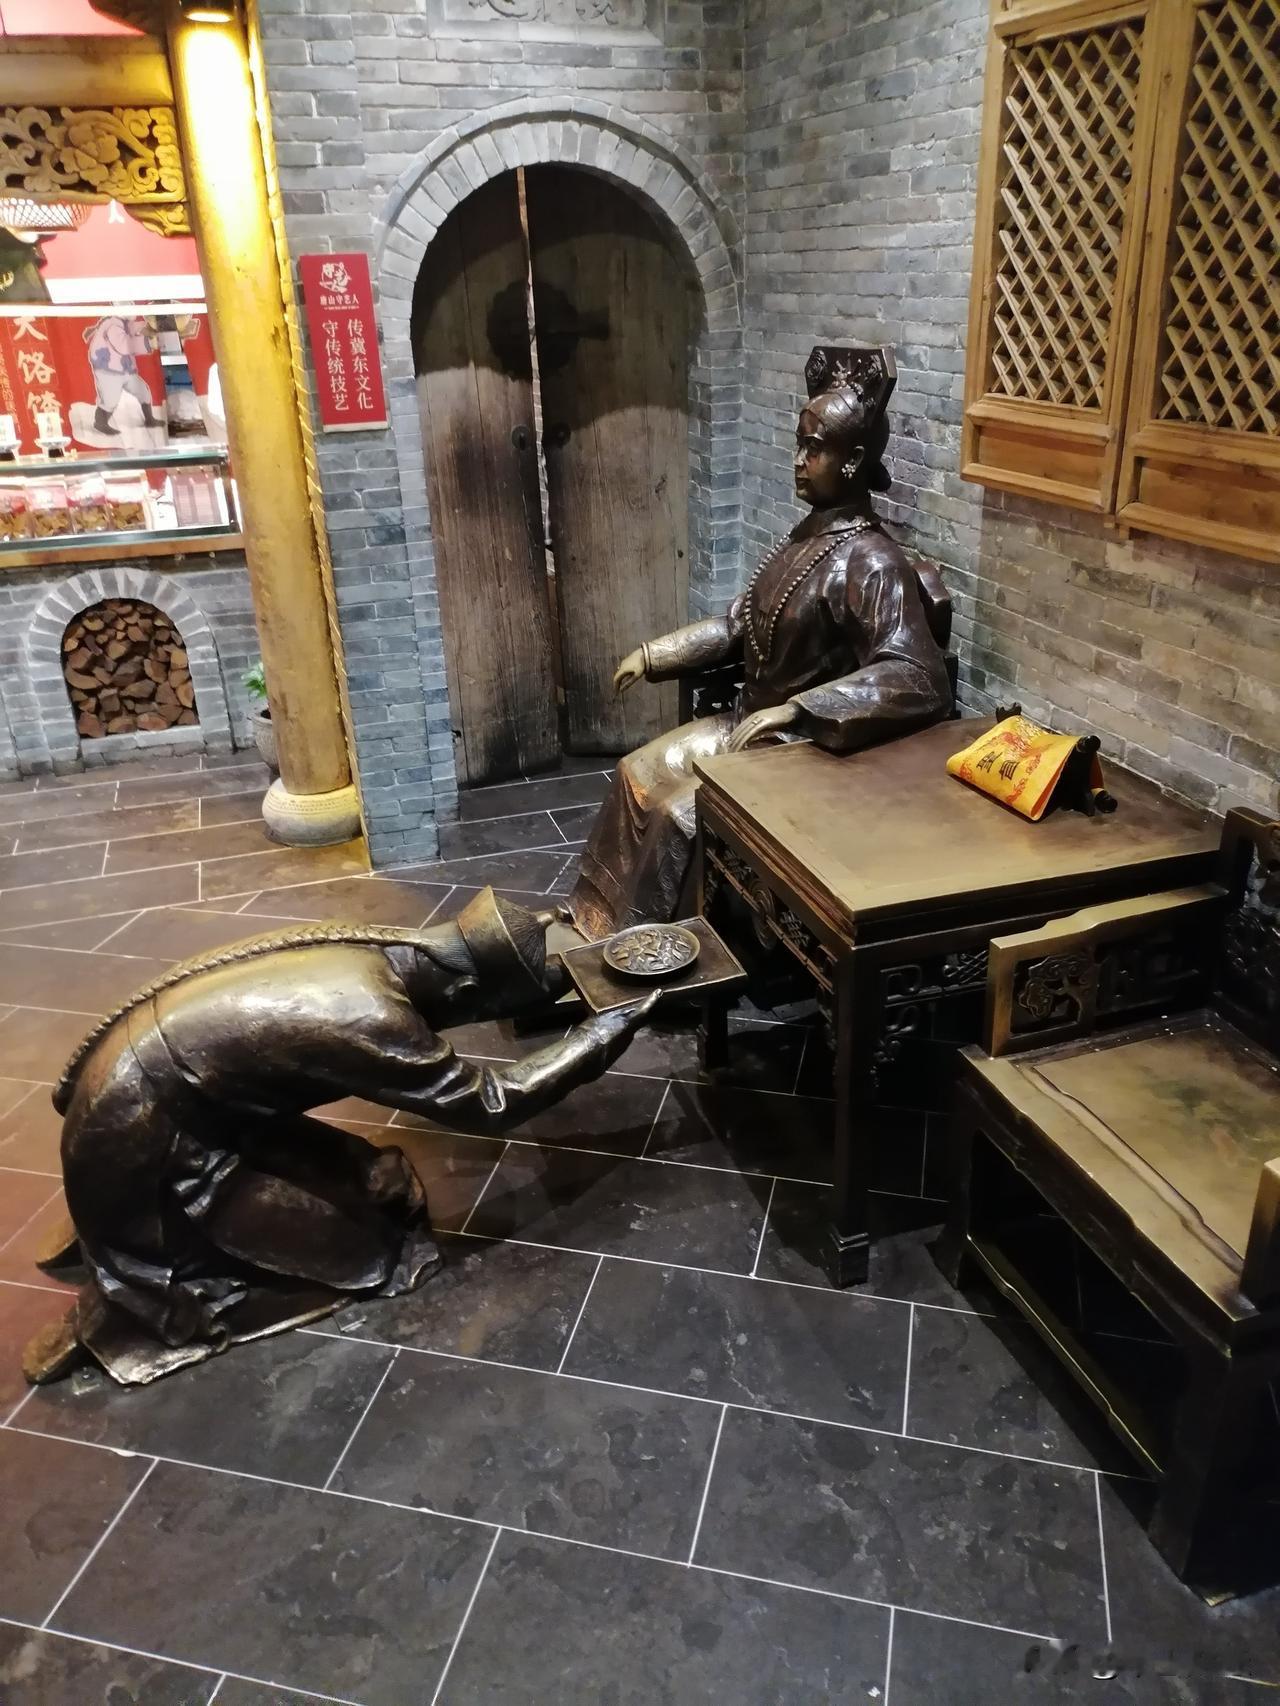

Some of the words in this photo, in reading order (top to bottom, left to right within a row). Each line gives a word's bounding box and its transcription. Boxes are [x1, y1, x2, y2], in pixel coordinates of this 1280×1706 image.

[321, 319, 350, 411] 守传统技艺
[347, 318, 374, 410] 传冀东文化
